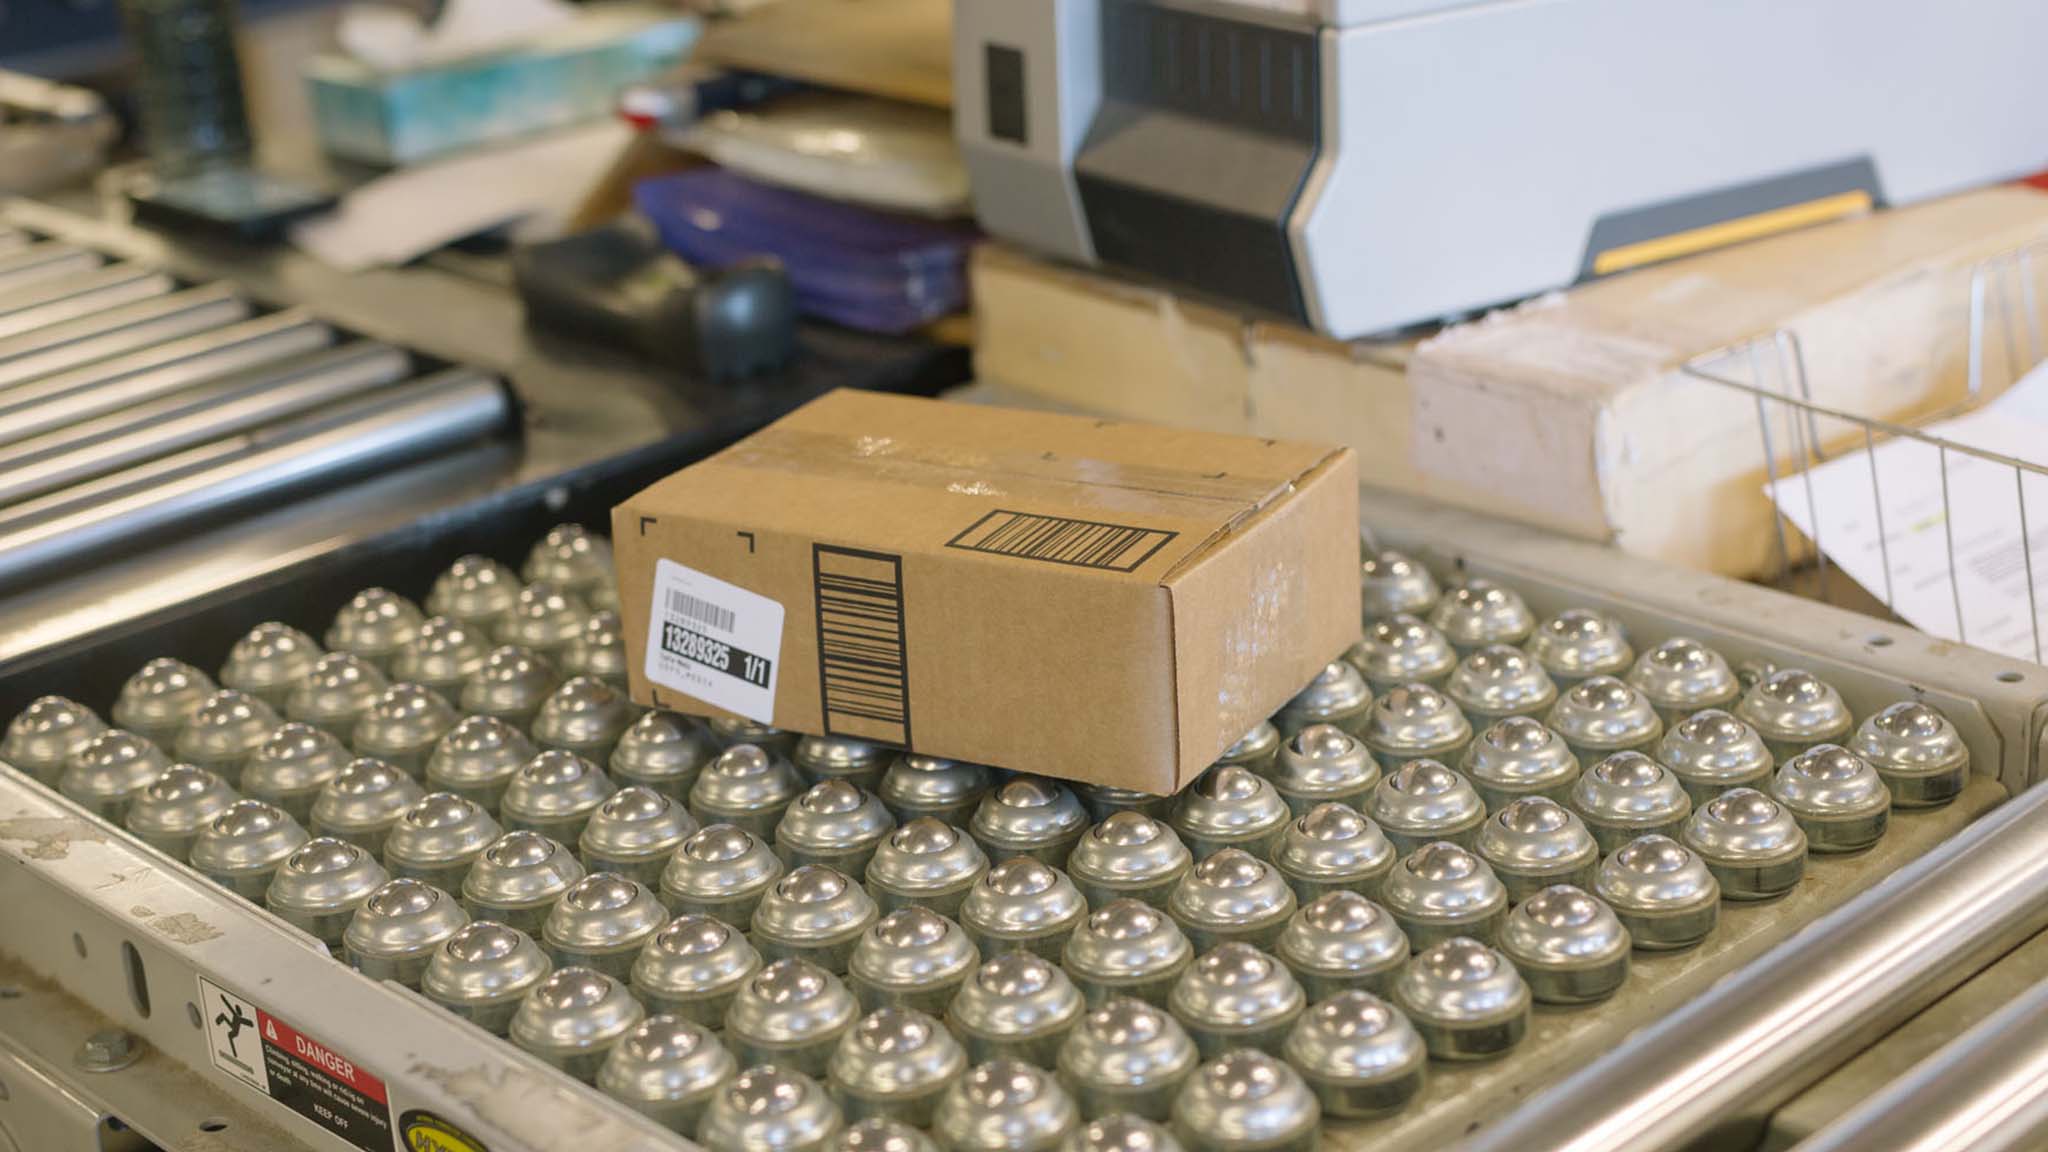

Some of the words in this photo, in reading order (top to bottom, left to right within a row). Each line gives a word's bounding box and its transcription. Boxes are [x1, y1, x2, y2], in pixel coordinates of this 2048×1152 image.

[665, 625, 730, 671] 13289325
[744, 655, 765, 685] 1/1
[295, 1035, 356, 1083] DANGER
[313, 1103, 333, 1119] KEEP
[334, 1115, 348, 1129] OFF
